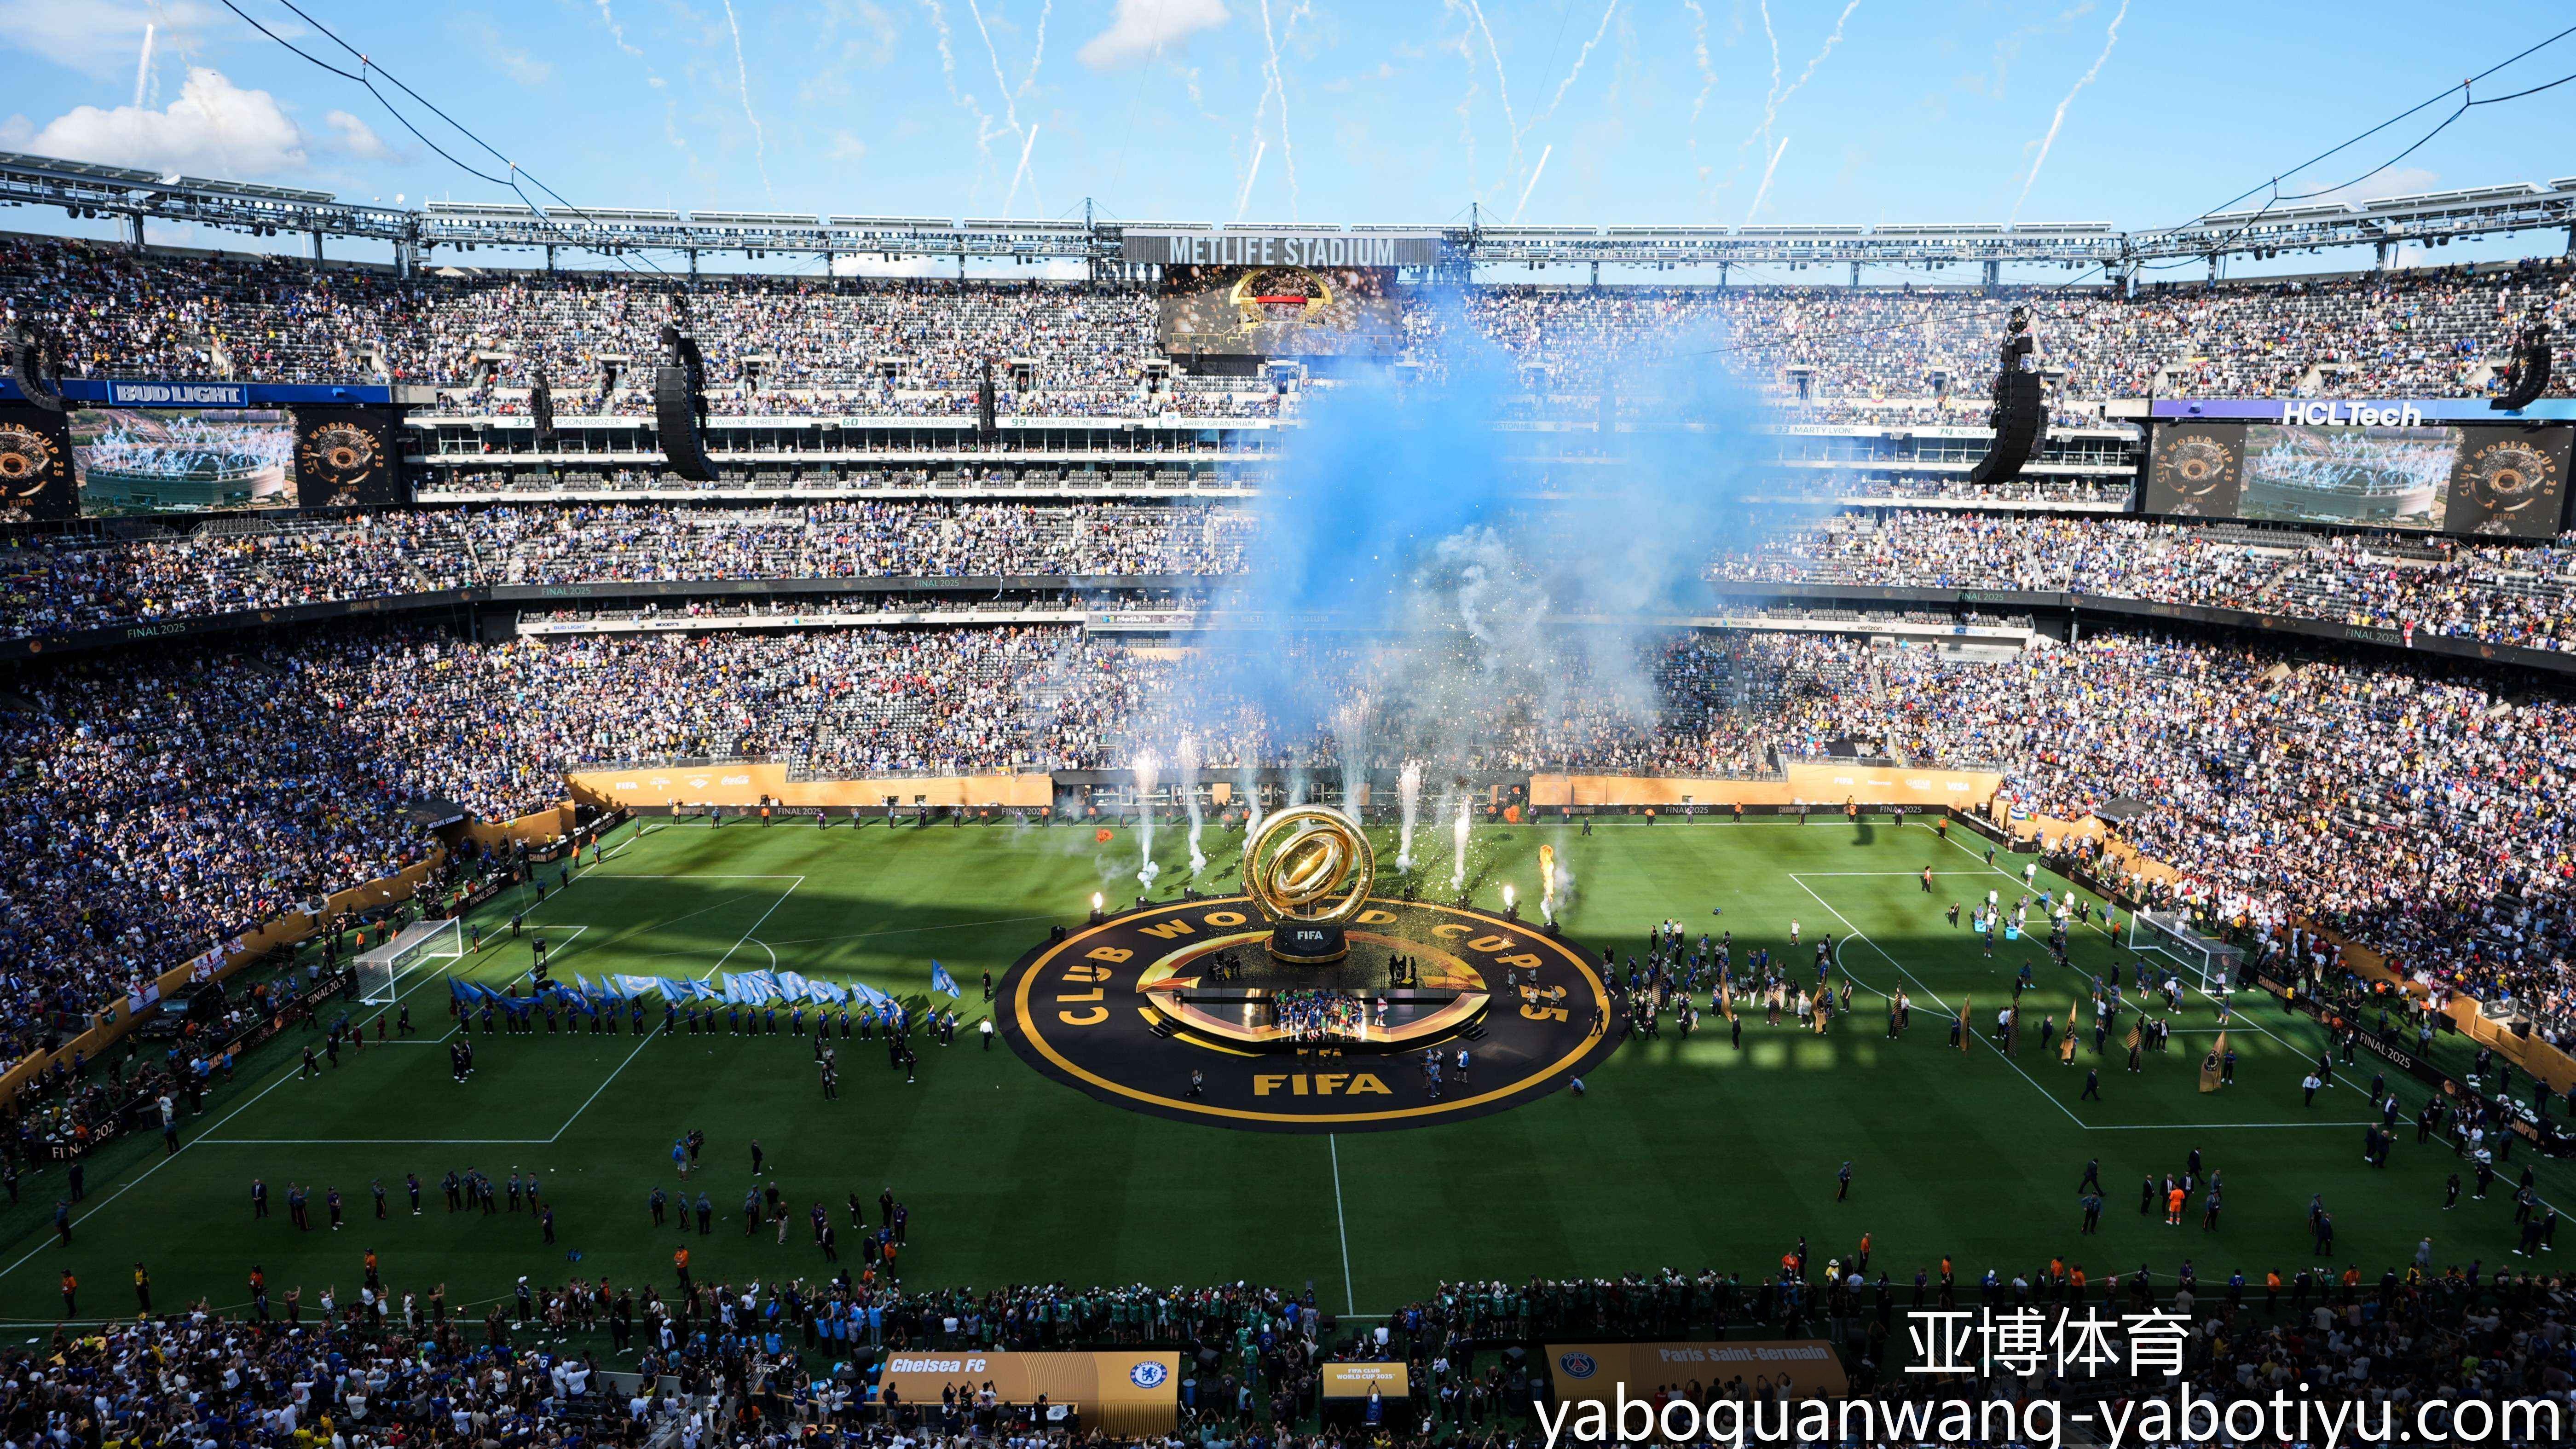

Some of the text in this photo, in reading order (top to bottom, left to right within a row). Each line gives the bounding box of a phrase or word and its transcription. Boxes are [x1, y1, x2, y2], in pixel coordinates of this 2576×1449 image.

[1170, 237, 1394, 266] METLIFE STADIUM
[116, 385, 241, 403] BUD LIGHT
[514, 418, 530, 426] 32
[2282, 402, 2422, 426] HCLTech
[1011, 418, 1027, 427] 99
[1774, 425, 1790, 433] 93
[33, 432, 64, 477] CUP 25
[301, 421, 384, 474] CLUB WORLD CUP 25
[2156, 435, 2235, 483] CLUB WORLD CUP 25
[2459, 440, 2557, 497] CLUB WORLD CUP 25
[339, 485, 360, 494] FIFA
[8, 498, 35, 508] FIFA
[2492, 513, 2516, 521] FIFA
[570, 587, 591, 595] 2025
[1984, 593, 2004, 601] 2025
[127, 623, 186, 639] FINAL 2025
[2345, 628, 2400, 644] FINAL 2025
[616, 781, 638, 790] FIFA
[1834, 777, 1854, 785] FIFA
[1946, 781, 1970, 791] VISA
[427, 814, 464, 830] METLIFE STADIUM
[2041, 857, 2051, 868] 025
[469, 883, 499, 906] FINAL 2025
[1297, 930, 1324, 941] FIFA
[1057, 909, 1570, 1026] CLUB WOD CUP 25
[307, 974, 347, 1005] FINAL 205
[2257, 973, 2287, 998] CHAMPION
[2359, 1032, 2412, 1069] FINAL 2025
[1253, 1073, 1393, 1096] FIFA
[95, 1120, 115, 1143] 202
[1658, 1345, 1829, 1362] Paris Saint-Germain
[539, 1359, 548, 1368] 10
[890, 1358, 986, 1373] Chelsea FC
